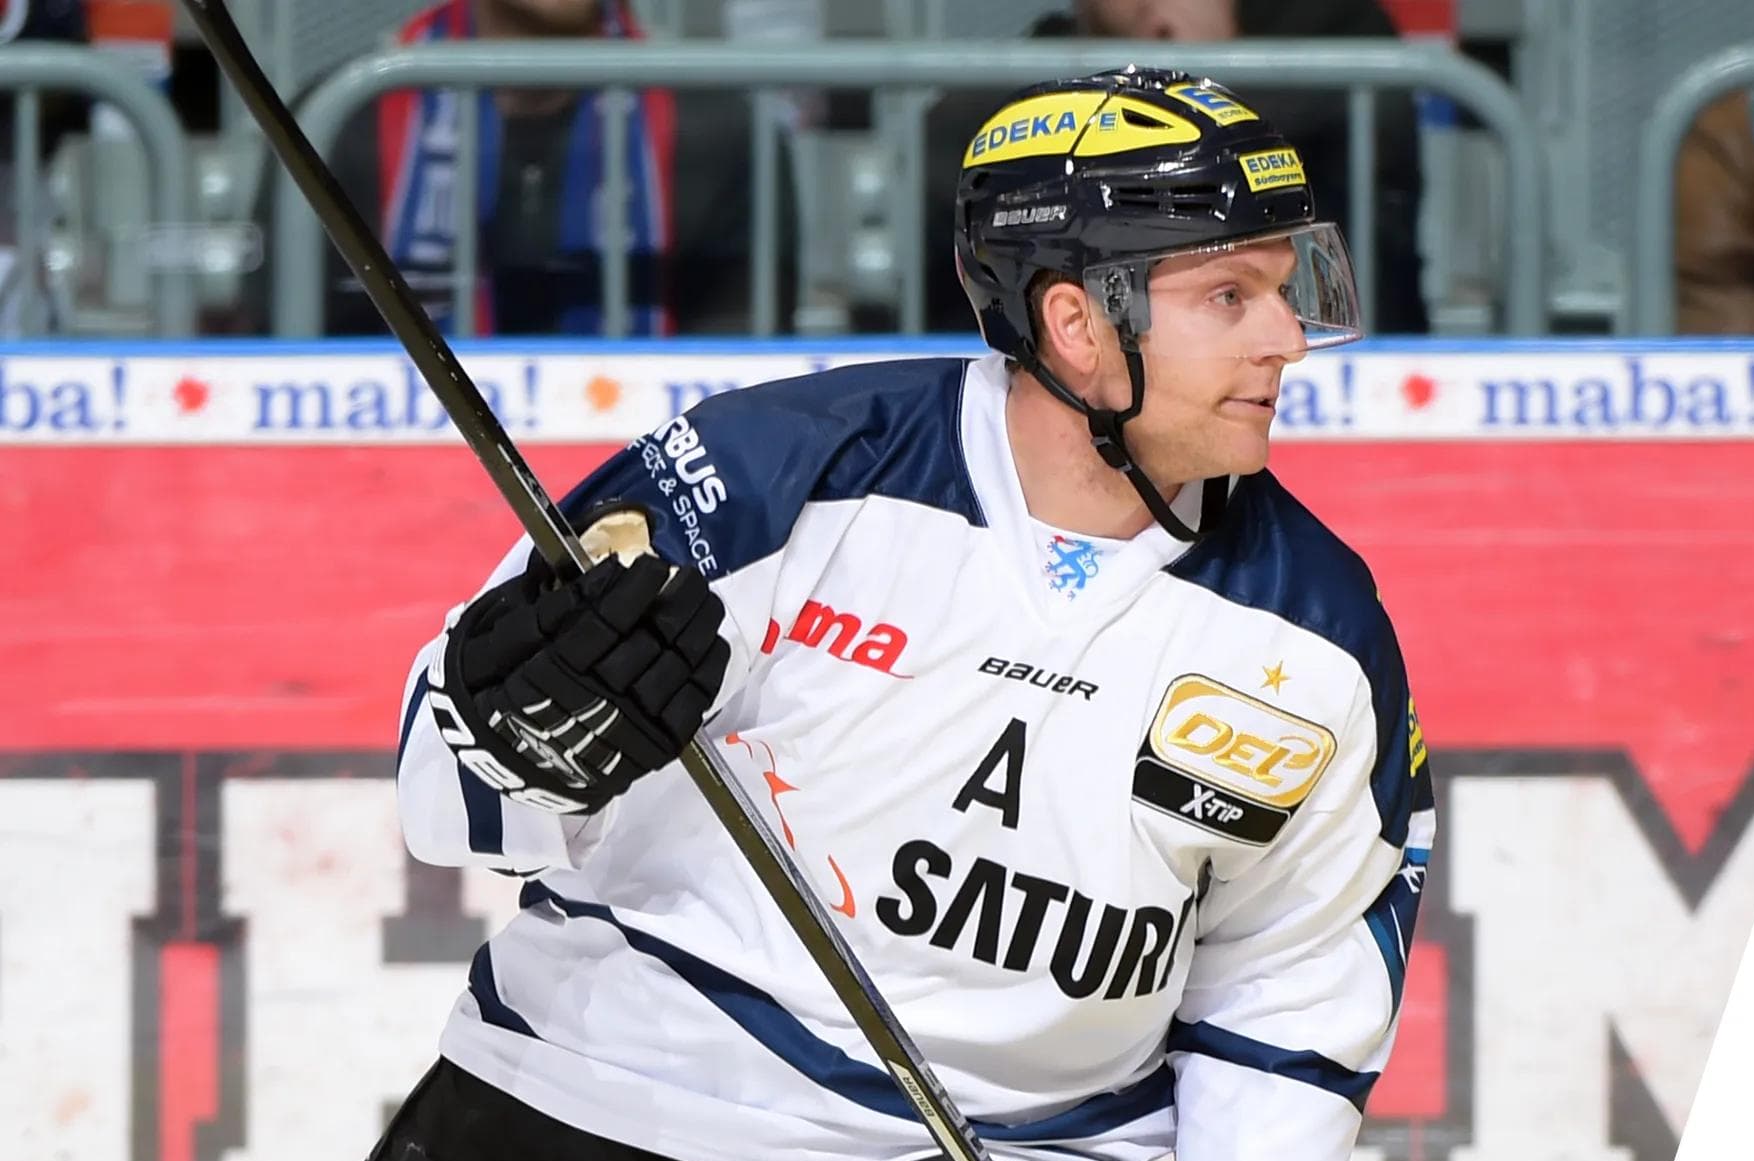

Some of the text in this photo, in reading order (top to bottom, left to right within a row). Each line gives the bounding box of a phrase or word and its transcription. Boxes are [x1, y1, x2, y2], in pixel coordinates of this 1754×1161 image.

[972, 111, 1076, 158] EDEKA
[1246, 152, 1298, 174] EDEKA
[672, 494, 718, 577] SPACE
[951, 716, 1028, 831] A
